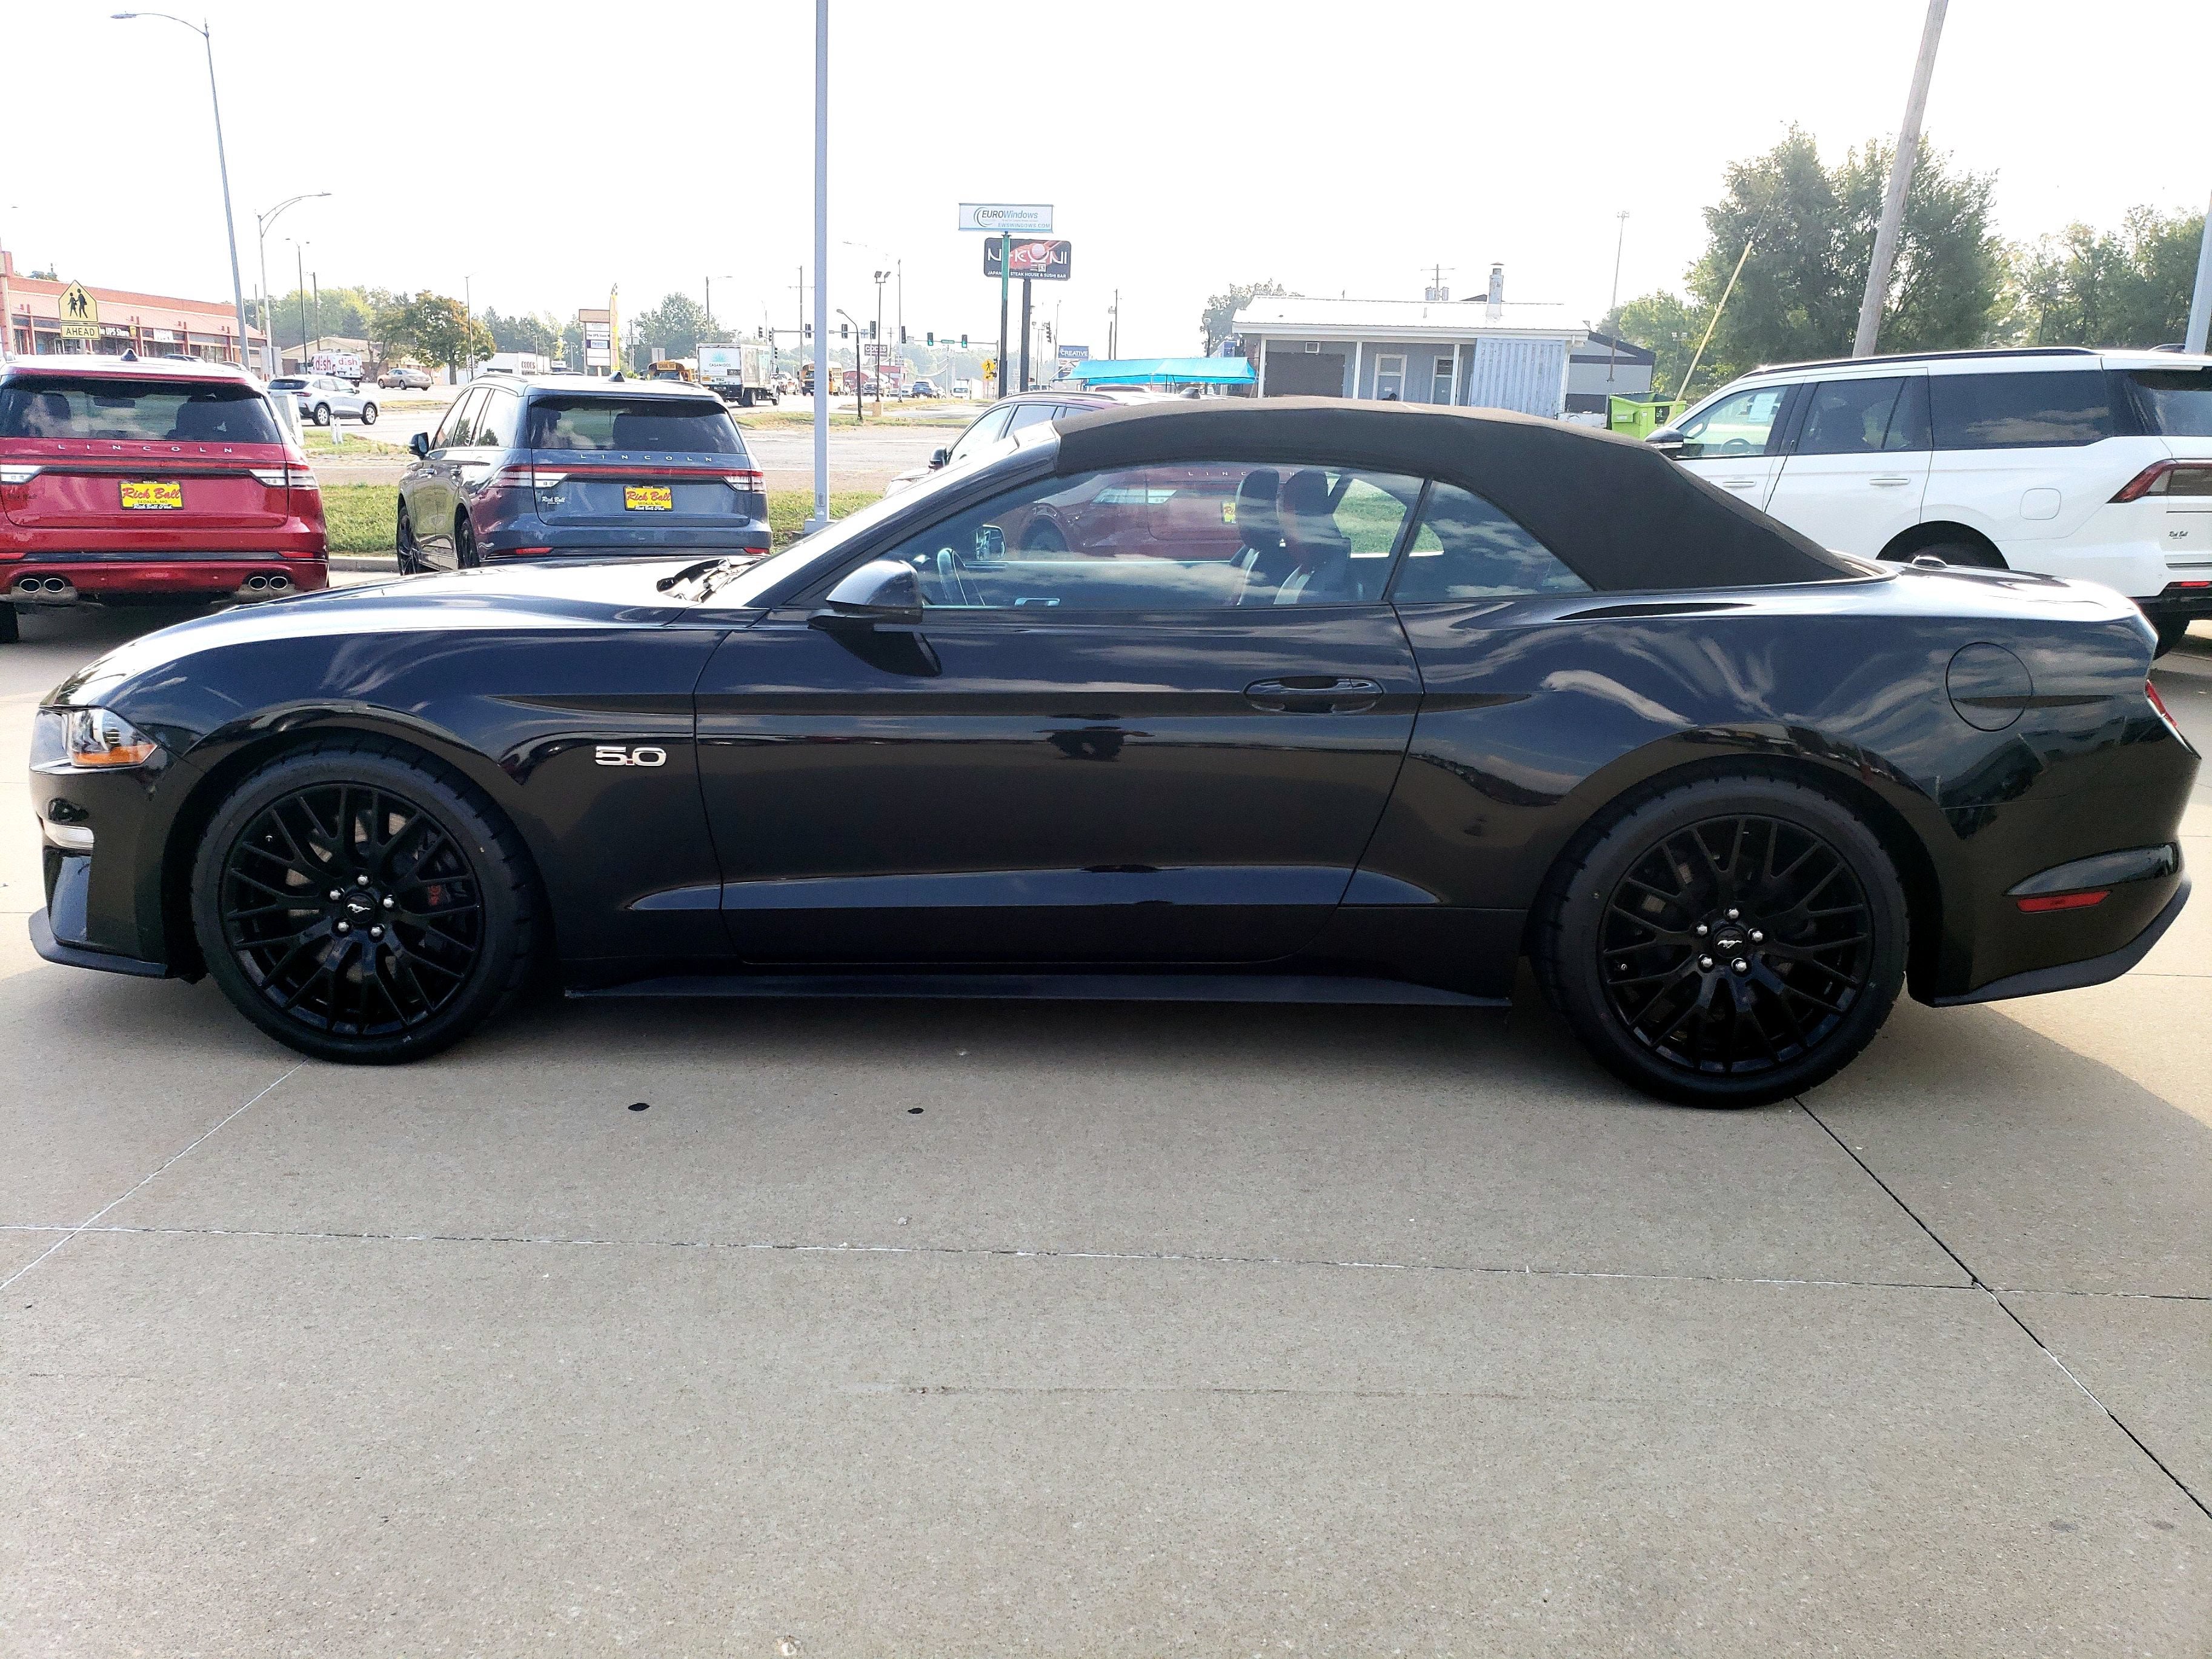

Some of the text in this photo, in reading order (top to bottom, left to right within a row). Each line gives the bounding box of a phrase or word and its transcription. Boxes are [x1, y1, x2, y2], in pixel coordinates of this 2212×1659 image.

[982, 210, 1038, 219] EUROWindows
[66, 327, 95, 336] AHEAD
[106, 327, 117, 336] UPS
[315, 355, 331, 371] dish
[58, 444, 233, 453] LINCOLN
[122, 487, 181, 499] Rick Ball
[626, 491, 672, 501] Rick Ball
[595, 746, 666, 766] 5.0
